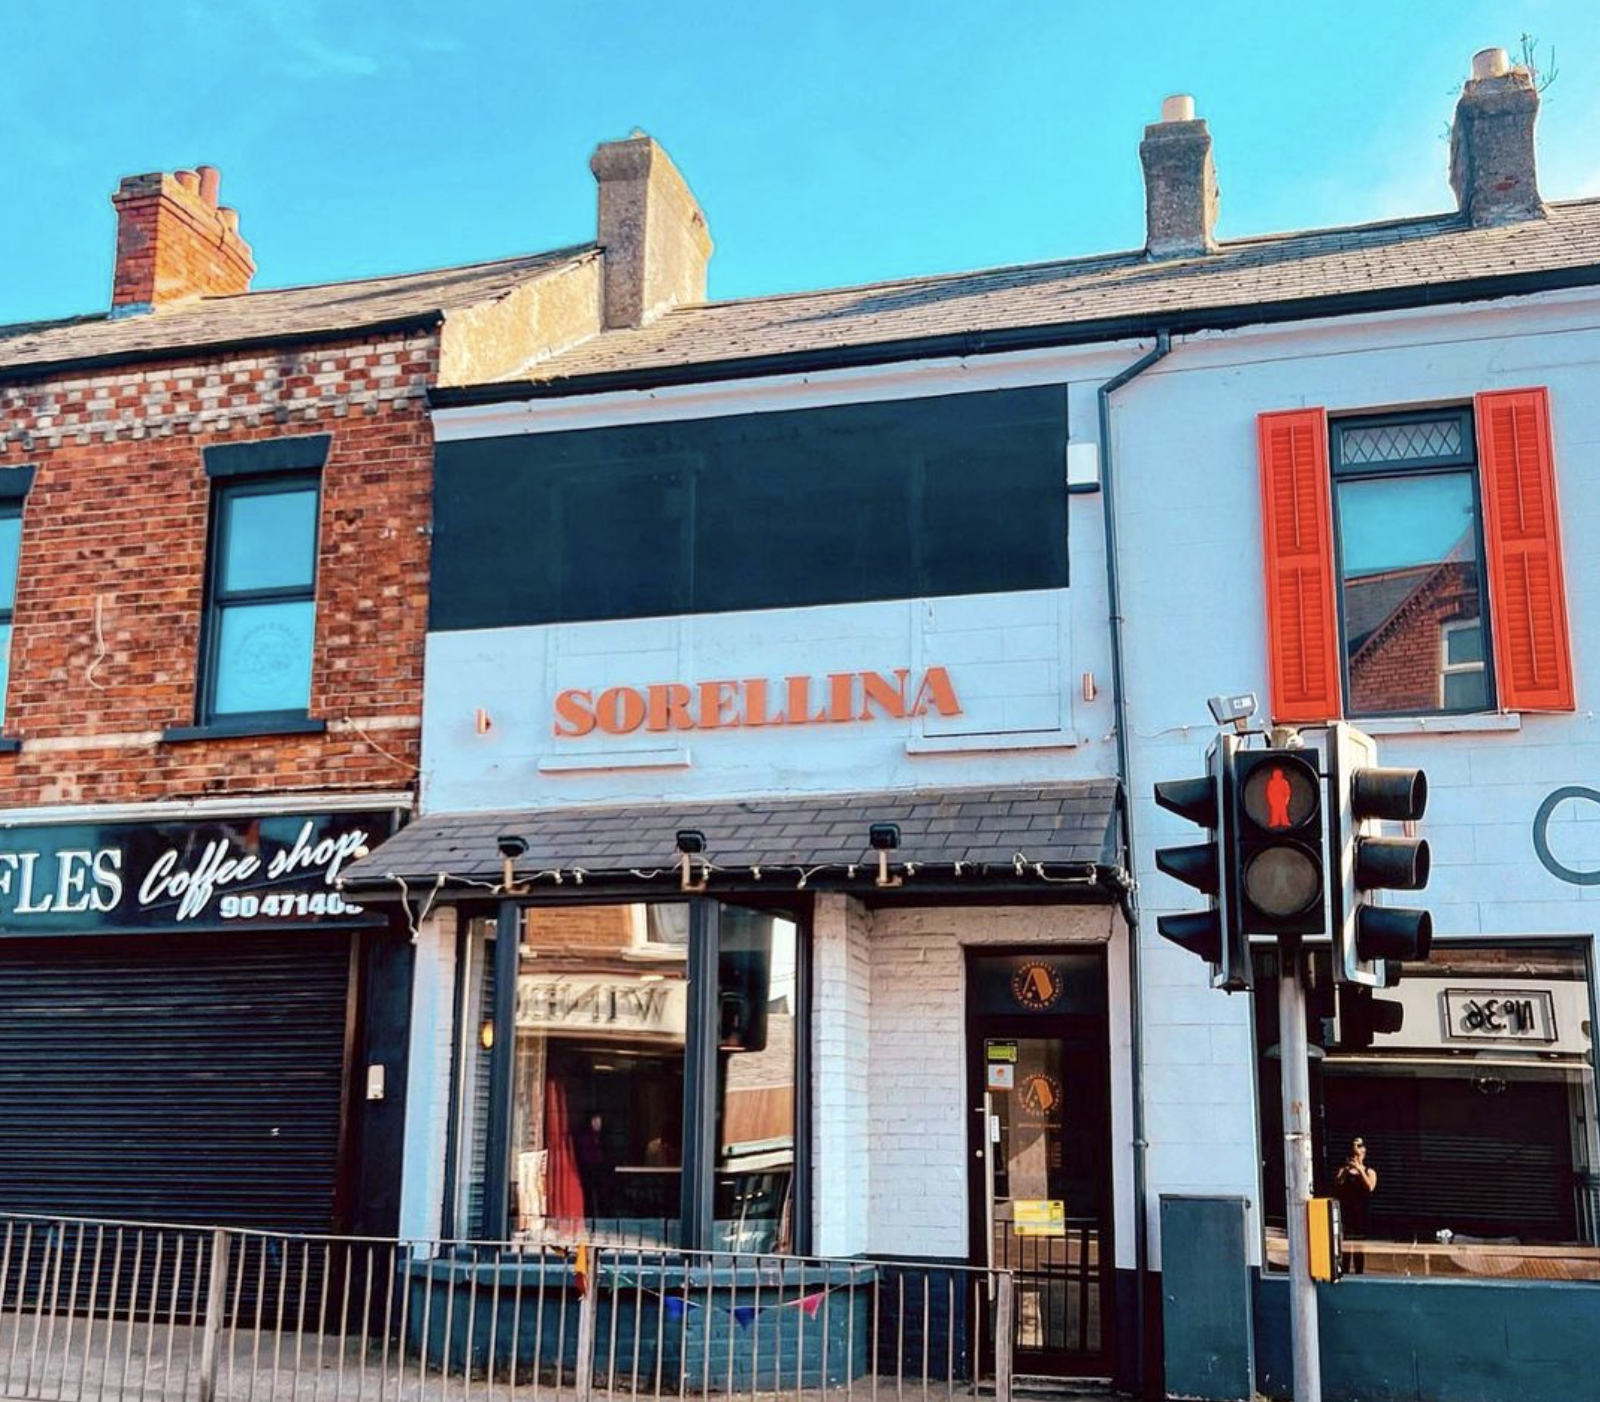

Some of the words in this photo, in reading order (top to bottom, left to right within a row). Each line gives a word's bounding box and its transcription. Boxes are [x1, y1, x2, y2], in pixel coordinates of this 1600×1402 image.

[553, 666, 963, 736] SORELLINA
[139, 838, 261, 921] Coffee
[267, 820, 368, 884] shop
